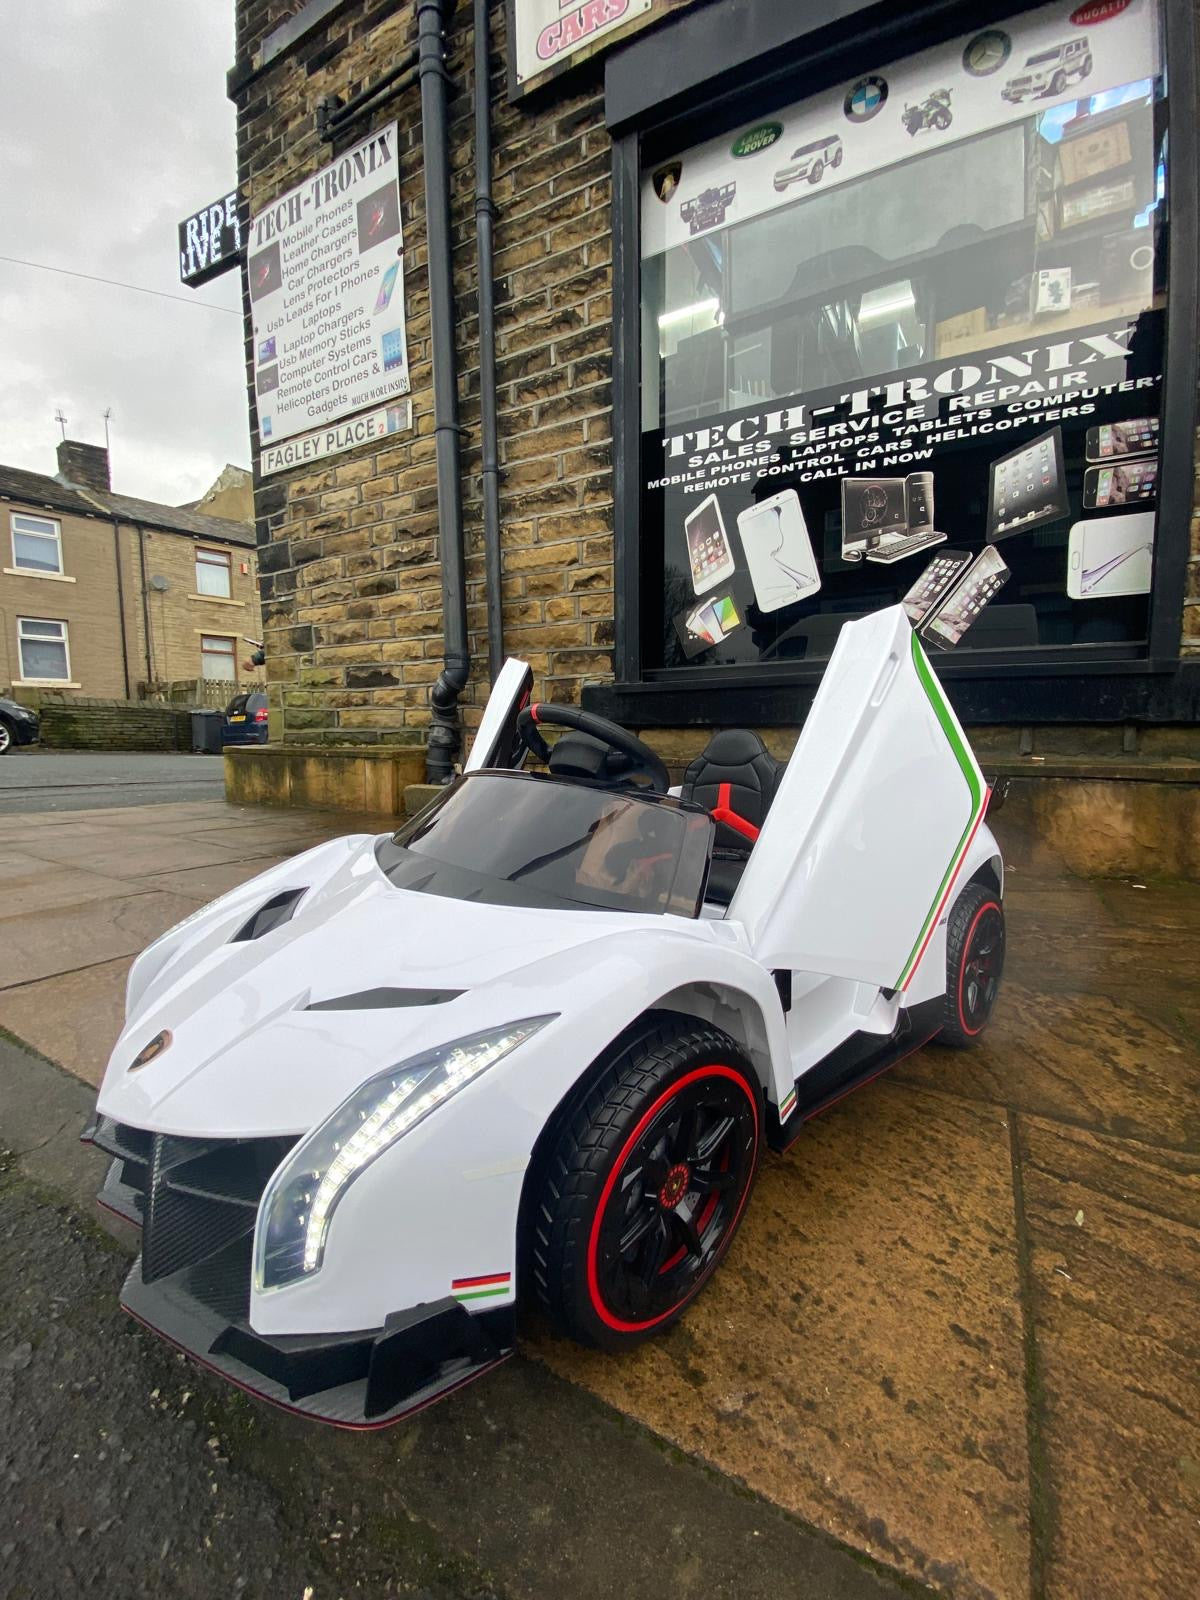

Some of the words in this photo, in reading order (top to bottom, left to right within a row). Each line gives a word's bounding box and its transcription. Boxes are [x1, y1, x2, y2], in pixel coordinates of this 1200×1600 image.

[537, 0, 629, 60] CARS
[743, 133, 776, 154] ROVER
[255, 130, 392, 247] TECH-TRONIX
[186, 193, 238, 254] RIDE
[282, 223, 313, 249] Mobile
[316, 198, 353, 228] Phones
[283, 235, 318, 263] Leather
[322, 214, 354, 239] Cases
[282, 258, 309, 280] Home
[312, 228, 358, 262] Chargers
[288, 276, 307, 291] Car
[307, 247, 353, 283] Chargers
[267, 317, 284, 333] Usb
[286, 300, 314, 323] Leads
[315, 290, 332, 307] For
[341, 265, 380, 293] Phones
[283, 290, 306, 309] Lens
[308, 260, 360, 296] Protectors
[283, 332, 316, 354] Laptop
[318, 306, 365, 336] Chargers
[302, 302, 342, 329] Laptops
[279, 354, 297, 370] Usb
[300, 335, 337, 360] Memory
[340, 318, 371, 341] Sticks
[280, 357, 326, 384] Computer
[328, 335, 372, 363] Systems
[277, 380, 312, 400] Remote
[314, 363, 350, 384] Control
[353, 349, 378, 367] Cars
[277, 384, 330, 414] Helicopters
[332, 368, 369, 391] Drones
[372, 363, 381, 375] &
[351, 390, 369, 407] MUCH
[371, 384, 388, 400] MORE
[388, 377, 408, 393] INSIDE
[662, 328, 1136, 458] TECH-TRONIX
[307, 393, 348, 417] Gadgets
[688, 439, 772, 468] SALES
[790, 405, 926, 445] SERVICE
[949, 370, 1088, 412] REPAIR
[267, 437, 321, 469] FAGLEY
[326, 418, 375, 452] PLACE
[378, 423, 385, 434] 2
[647, 469, 706, 490] MOBILE
[711, 453, 781, 475] PHONES
[792, 432, 880, 459] LAPTOPS
[892, 408, 992, 437] TABLETS
[1008, 374, 1163, 414] COMPUTER
[684, 471, 751, 494] REMOTE
[756, 453, 845, 478] CONTROL
[857, 439, 913, 458] CARS
[926, 403, 1097, 444] HELICOPTERS
[800, 467, 849, 482] CALL
[855, 458, 877, 472] IN
[883, 448, 934, 467] NOW
